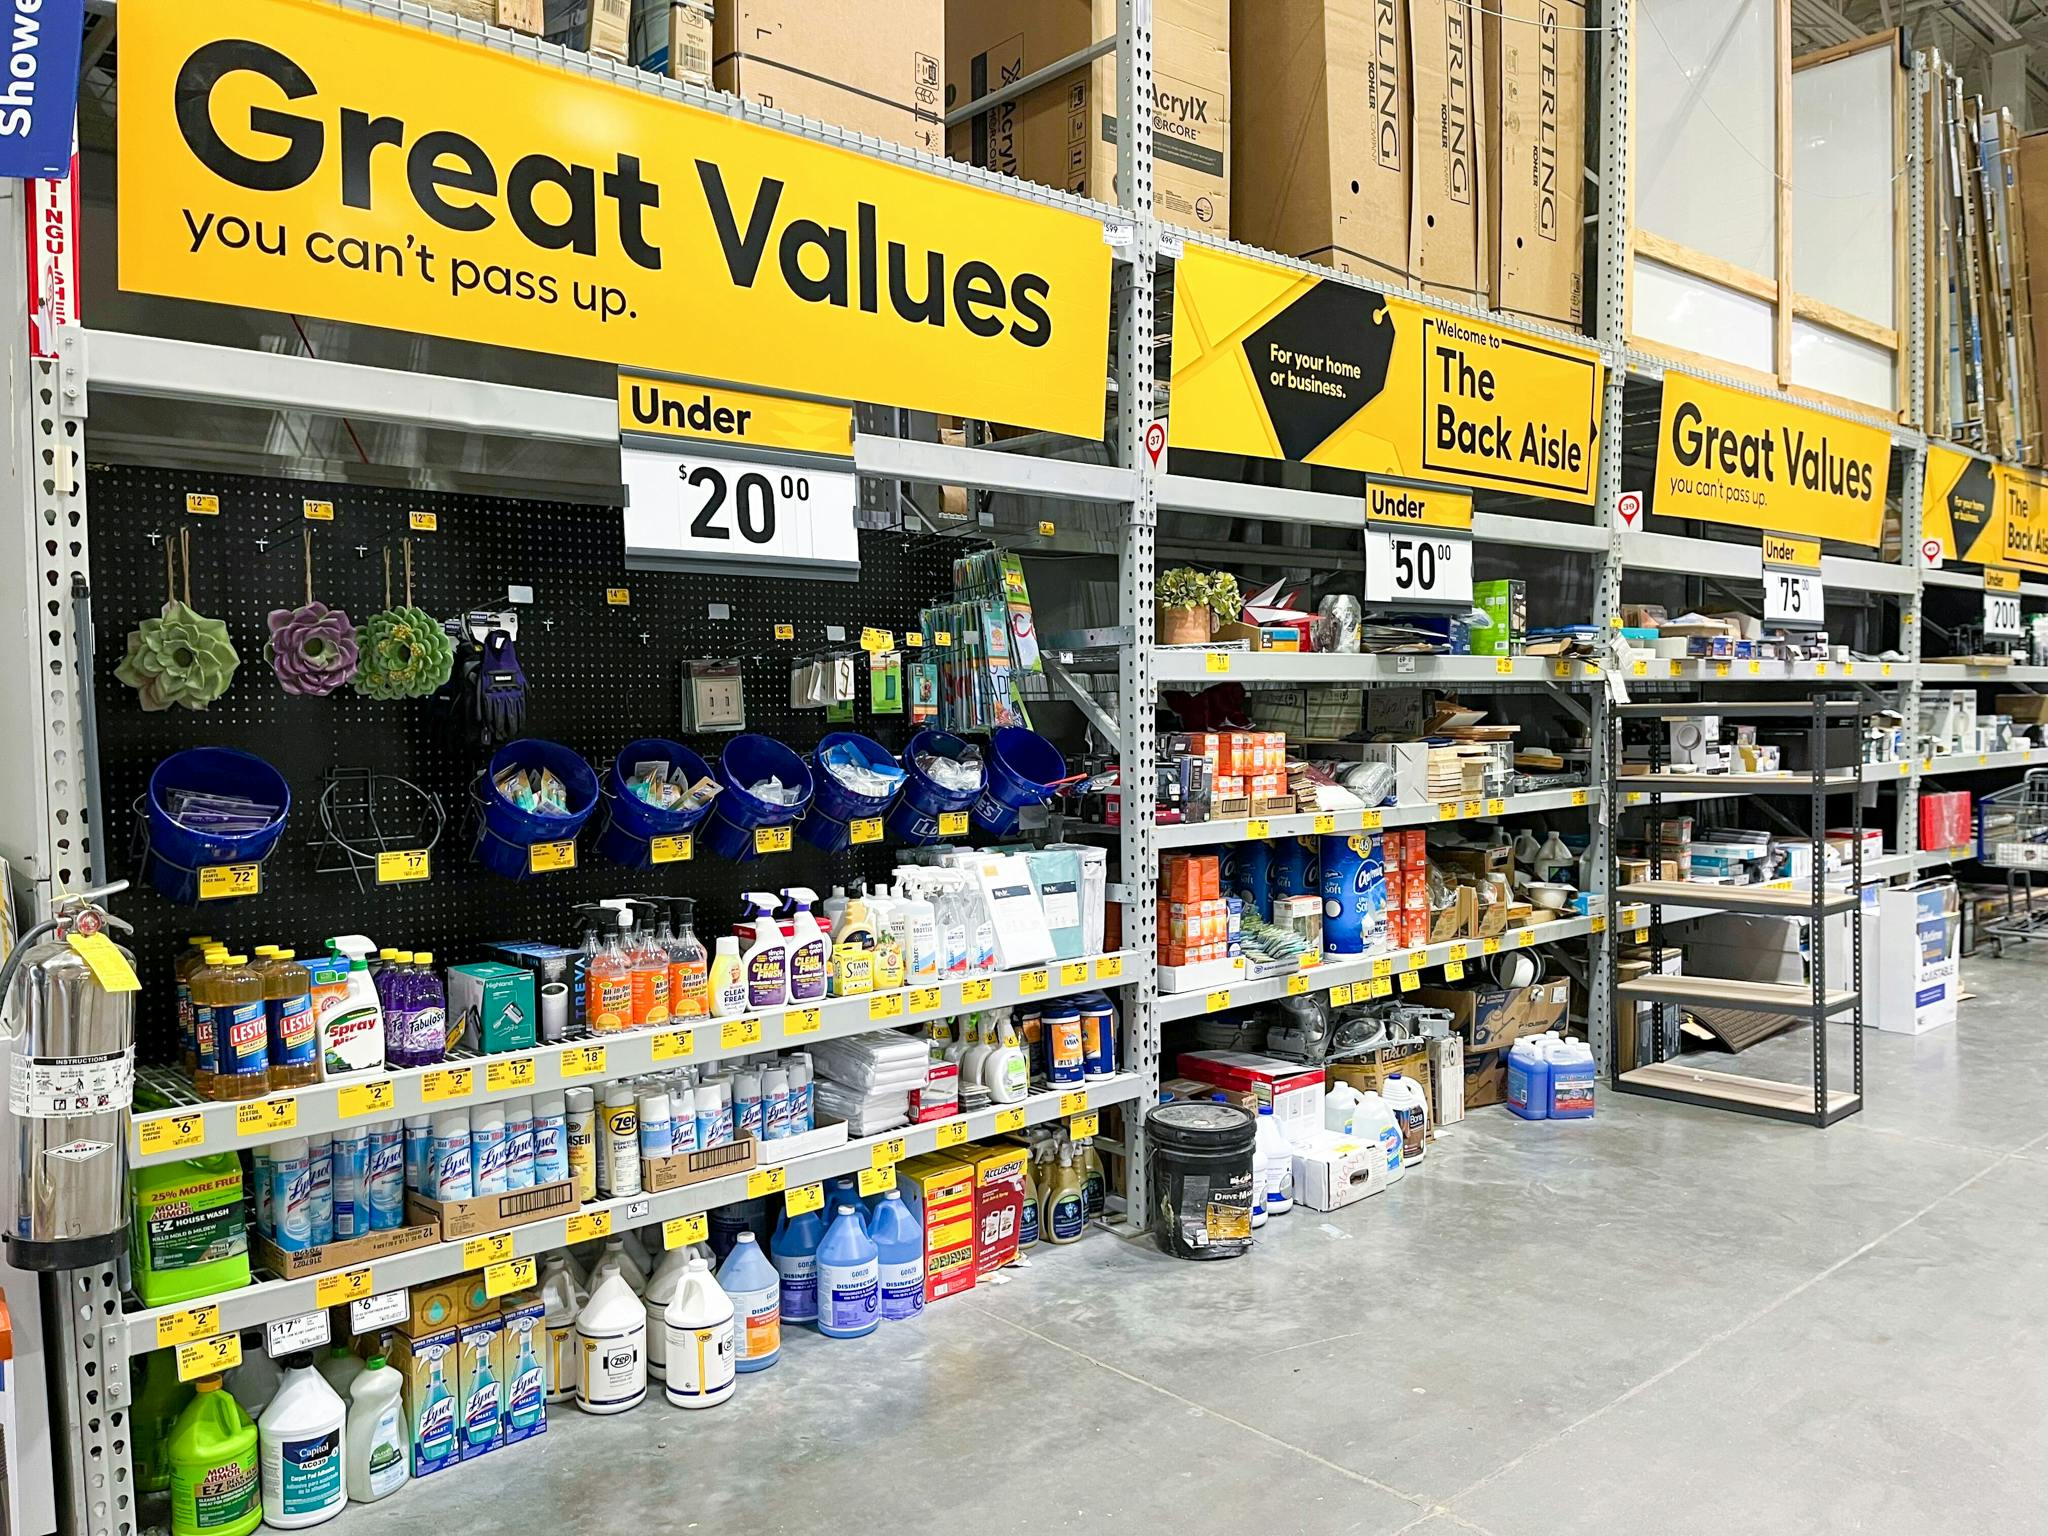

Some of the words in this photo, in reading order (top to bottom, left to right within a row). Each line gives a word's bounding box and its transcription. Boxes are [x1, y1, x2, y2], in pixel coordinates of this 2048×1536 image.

[1367, 61, 1376, 110] KOHLER
[1440, 104, 1448, 148] KOHLER
[1540, 12, 1556, 232] STERLING
[175, 39, 662, 271] Great
[694, 158, 1052, 348] Values
[182, 208, 287, 256] you
[451, 257, 559, 304] pass
[573, 282, 638, 322] up.
[1436, 318, 1487, 347] Welcome
[1488, 334, 1500, 349] to
[1270, 343, 1291, 364] For
[1294, 350, 1324, 374] your
[1326, 357, 1361, 380] home
[1436, 347, 1495, 401] The
[1270, 371, 1286, 387] or
[1287, 374, 1347, 399] business.
[631, 385, 752, 436] Under
[1149, 434, 1160, 445] 37
[1436, 405, 1512, 461] Back
[1520, 422, 1582, 473] Aisle
[1672, 401, 1774, 482] Great
[1782, 427, 1873, 502] Values
[1670, 476, 1693, 497] you
[1726, 487, 1751, 505] pass
[1753, 490, 1768, 507] up.
[1372, 489, 1425, 520] Under
[1623, 503, 1635, 511] 39
[2008, 489, 2028, 518] The
[2008, 522, 2033, 550] Back
[1766, 539, 1794, 561] Under
[1987, 572, 2004, 587] Under
[1325, 884, 1342, 894] Soft
[752, 962, 780, 973] CLEAN
[794, 955, 820, 967] CLEAN
[486, 980, 514, 989] Highland
[757, 970, 784, 981] FINISH
[724, 988, 746, 997] CLEAN
[330, 1018, 377, 1038] Spray
[408, 1011, 445, 1035] Fabuloso
[56, 1055, 108, 1066] INSTRUCTIONS
[1382, 1045, 1408, 1062] HALO
[25, 1060, 33, 1114] WATER
[239, 1115, 263, 1123] CLEANER
[768, 1102, 788, 1120] Lysol
[1409, 1113, 1423, 1125] Bona
[672, 1125, 693, 1143] Lysol
[505, 1134, 534, 1159] Lysol
[440, 1151, 470, 1176] Lysol
[984, 1160, 1023, 1179] ACCUSHOT
[152, 1192, 178, 1202] 25%
[178, 1181, 214, 1197] MORE
[215, 1174, 241, 1188] FREE
[150, 1206, 193, 1221] ARMOR
[154, 1200, 188, 1213] MOLD
[151, 1220, 175, 1234] E-Z
[175, 1214, 206, 1227] HOUSE
[206, 1207, 230, 1220] WASH
[169, 1230, 188, 1240] MOLD
[511, 1368, 540, 1396] Lysol
[468, 1383, 498, 1412] Lysol
[518, 1395, 535, 1405] SMART
[422, 1398, 453, 1427] Lysol
[475, 1411, 492, 1421] SMART
[429, 1426, 447, 1436] SMART
[299, 1443, 329, 1457] Capitol
[207, 1462, 238, 1477] MOLD
[301, 1458, 327, 1470] AC039
[203, 1468, 241, 1484] ARMOR
[202, 1483, 224, 1496] E-Z
